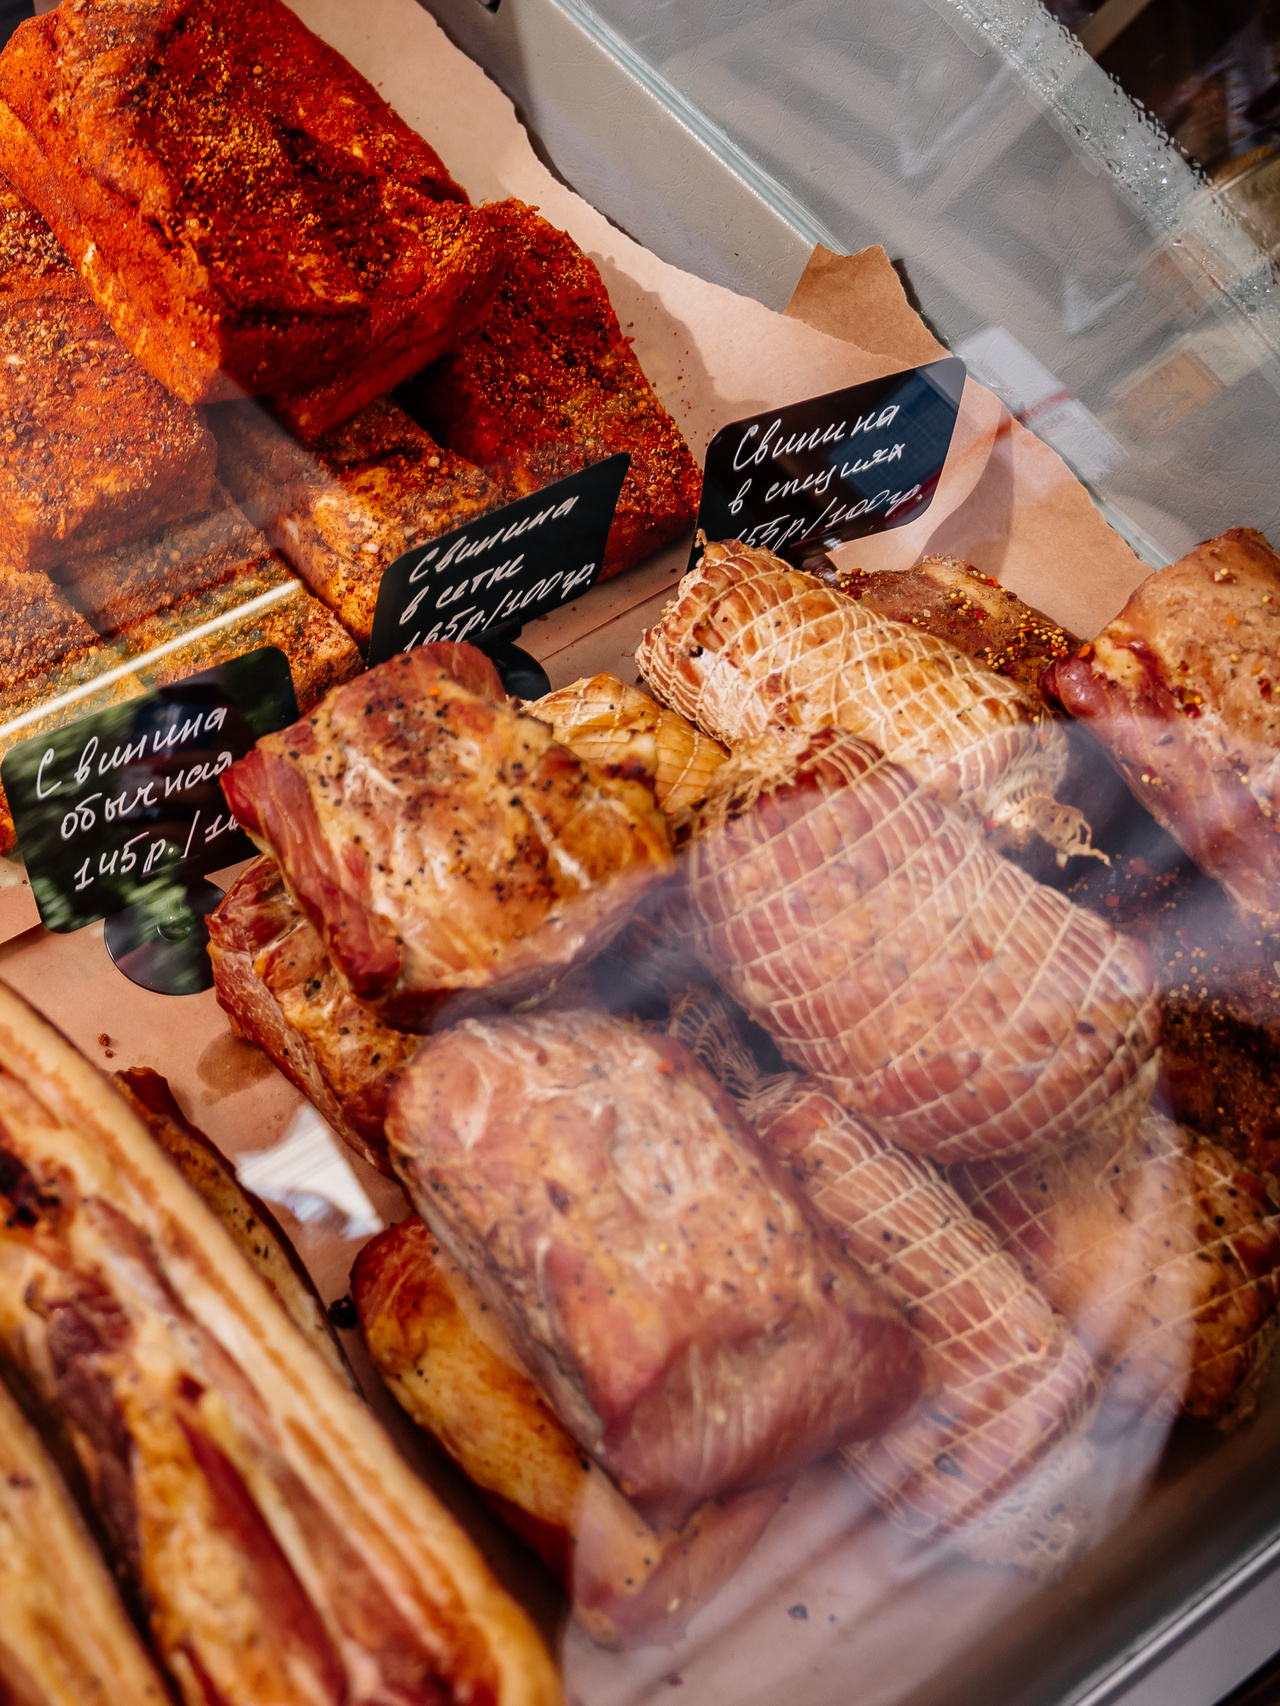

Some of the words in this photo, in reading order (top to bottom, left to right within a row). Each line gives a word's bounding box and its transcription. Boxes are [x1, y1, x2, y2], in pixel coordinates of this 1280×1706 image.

[732, 404, 901, 472] Свинина
[727, 477, 753, 516] в
[764, 442, 906, 504] специях
[408, 495, 579, 583] Свинина
[398, 586, 429, 626] в
[435, 553, 525, 609] сетке
[36, 707, 228, 800] Свинина
[60, 751, 234, 841] обычная
